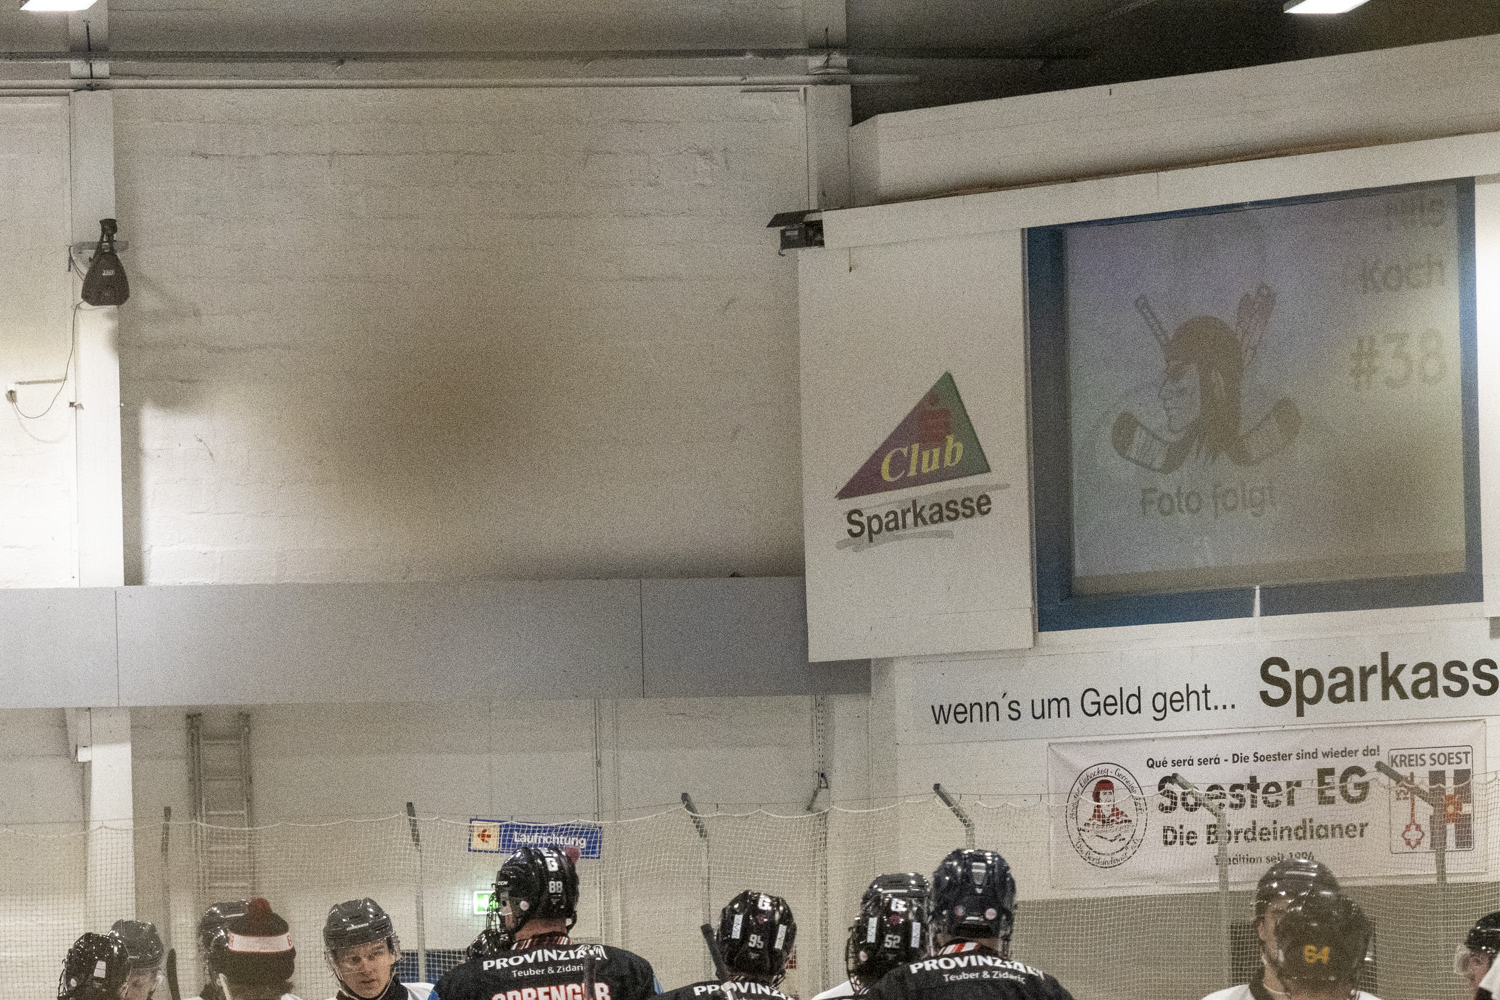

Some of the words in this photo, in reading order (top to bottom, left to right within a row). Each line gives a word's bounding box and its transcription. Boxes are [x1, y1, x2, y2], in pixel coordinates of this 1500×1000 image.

[880, 432, 965, 484] Club
[1140, 487, 1201, 518] Foto
[1212, 482, 1278, 518] folgt
[845, 491, 993, 543] Sparkasse
[1031, 694, 1070, 719] um
[1081, 686, 1142, 718] Geld
[1153, 683, 1237, 715] geht...
[1260, 651, 1500, 717] Sparkass
[1146, 756, 1168, 769] Qué
[1170, 755, 1194, 768] será
[1197, 754, 1221, 767] será
[1231, 752, 1250, 764] Die
[1253, 750, 1293, 763] Soester
[1295, 749, 1319, 761] sind
[1321, 747, 1359, 760] wieder
[1362, 745, 1381, 757] da!
[1390, 753, 1426, 767] KREIS
[1429, 751, 1471, 766] SOEST
[1157, 774, 1302, 814] Soester
[1316, 765, 1371, 806] EG
[514, 832, 587, 849] Laufrichtung
[1162, 824, 1198, 847] Die
[548, 881, 562, 893] 88
[884, 934, 900, 949] 52
[1304, 945, 1330, 964] 64
[512, 967, 545, 978] Teuber
[547, 965, 555, 974] &
[556, 963, 585, 974] Zidari
[943, 971, 979, 982] Teuber
[982, 970, 990, 978] &
[993, 970, 1026, 984] Zidaric
